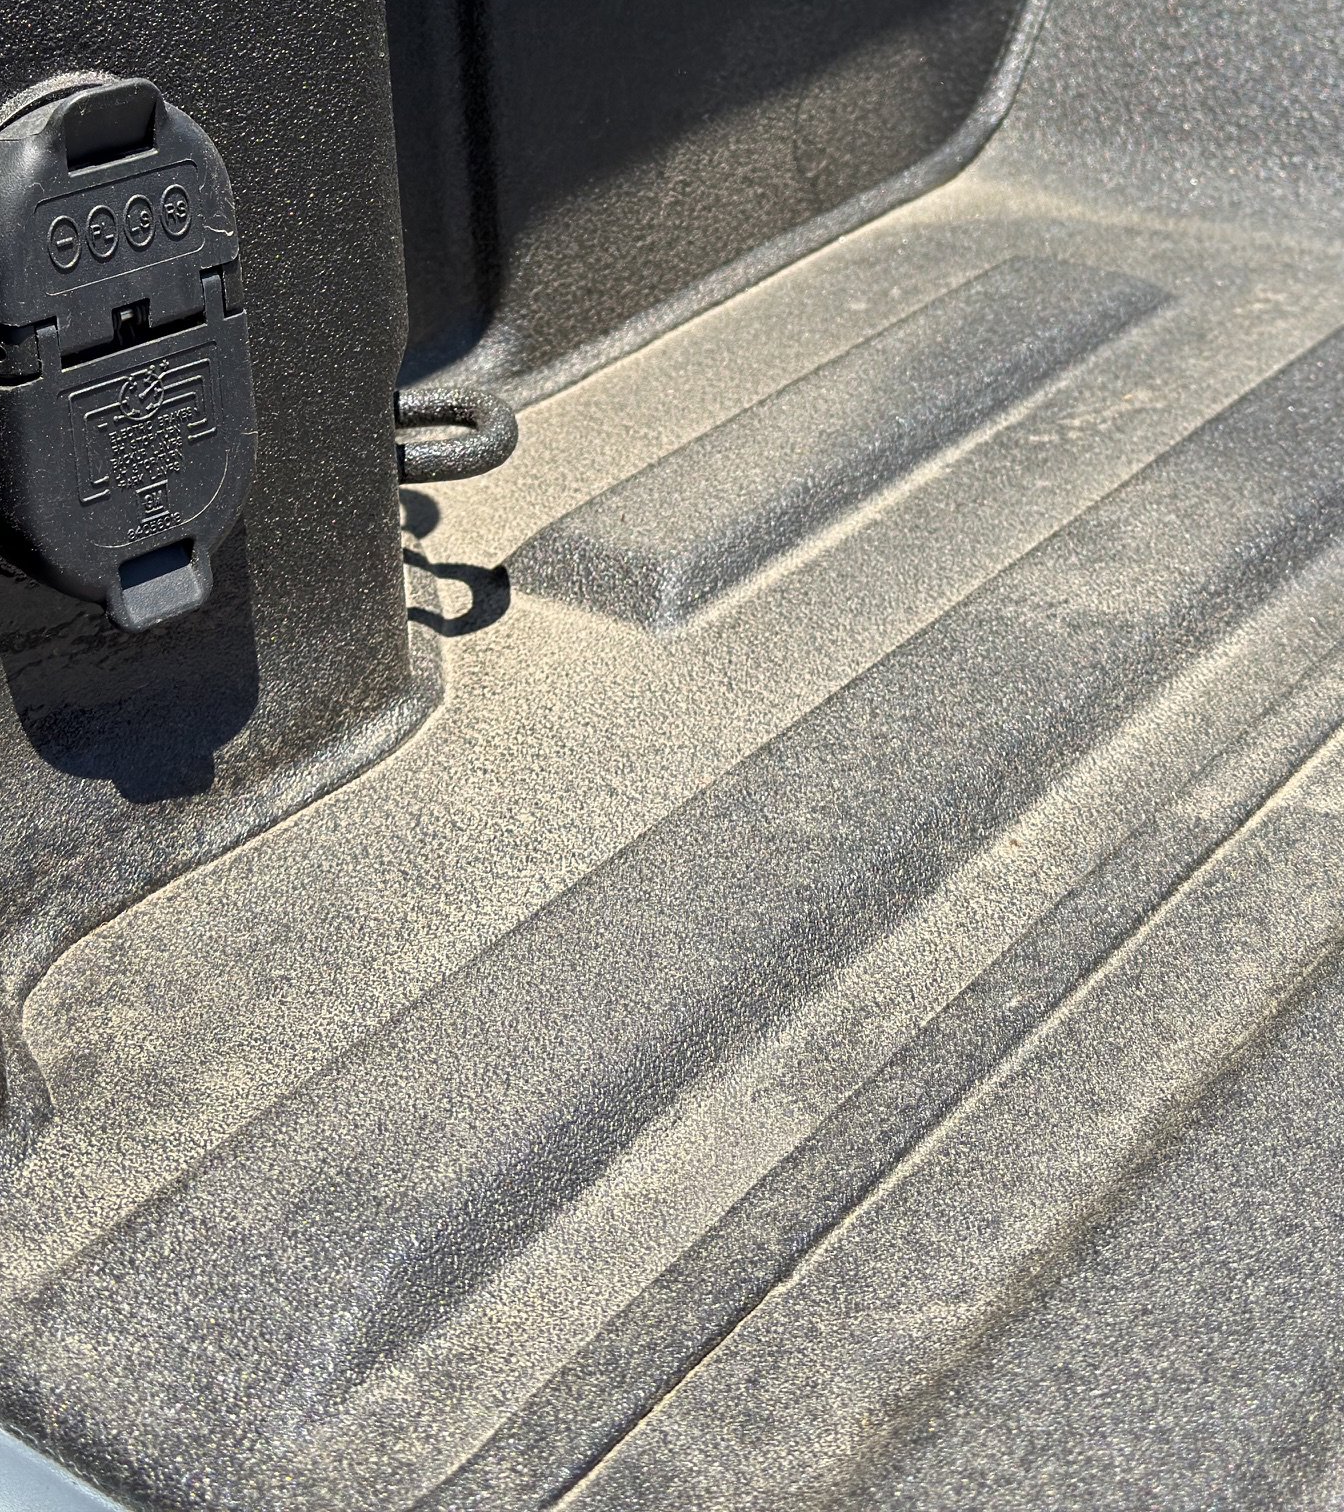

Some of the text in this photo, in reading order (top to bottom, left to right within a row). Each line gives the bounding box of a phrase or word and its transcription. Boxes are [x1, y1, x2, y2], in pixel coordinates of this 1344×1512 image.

[126, 209, 152, 233] LS
[163, 199, 187, 226] RS
[108, 406, 194, 445] ELECTRIC BRAKES
[109, 436, 184, 471] BACKUP LAMPS
[116, 460, 181, 492] PARK LAMPS
